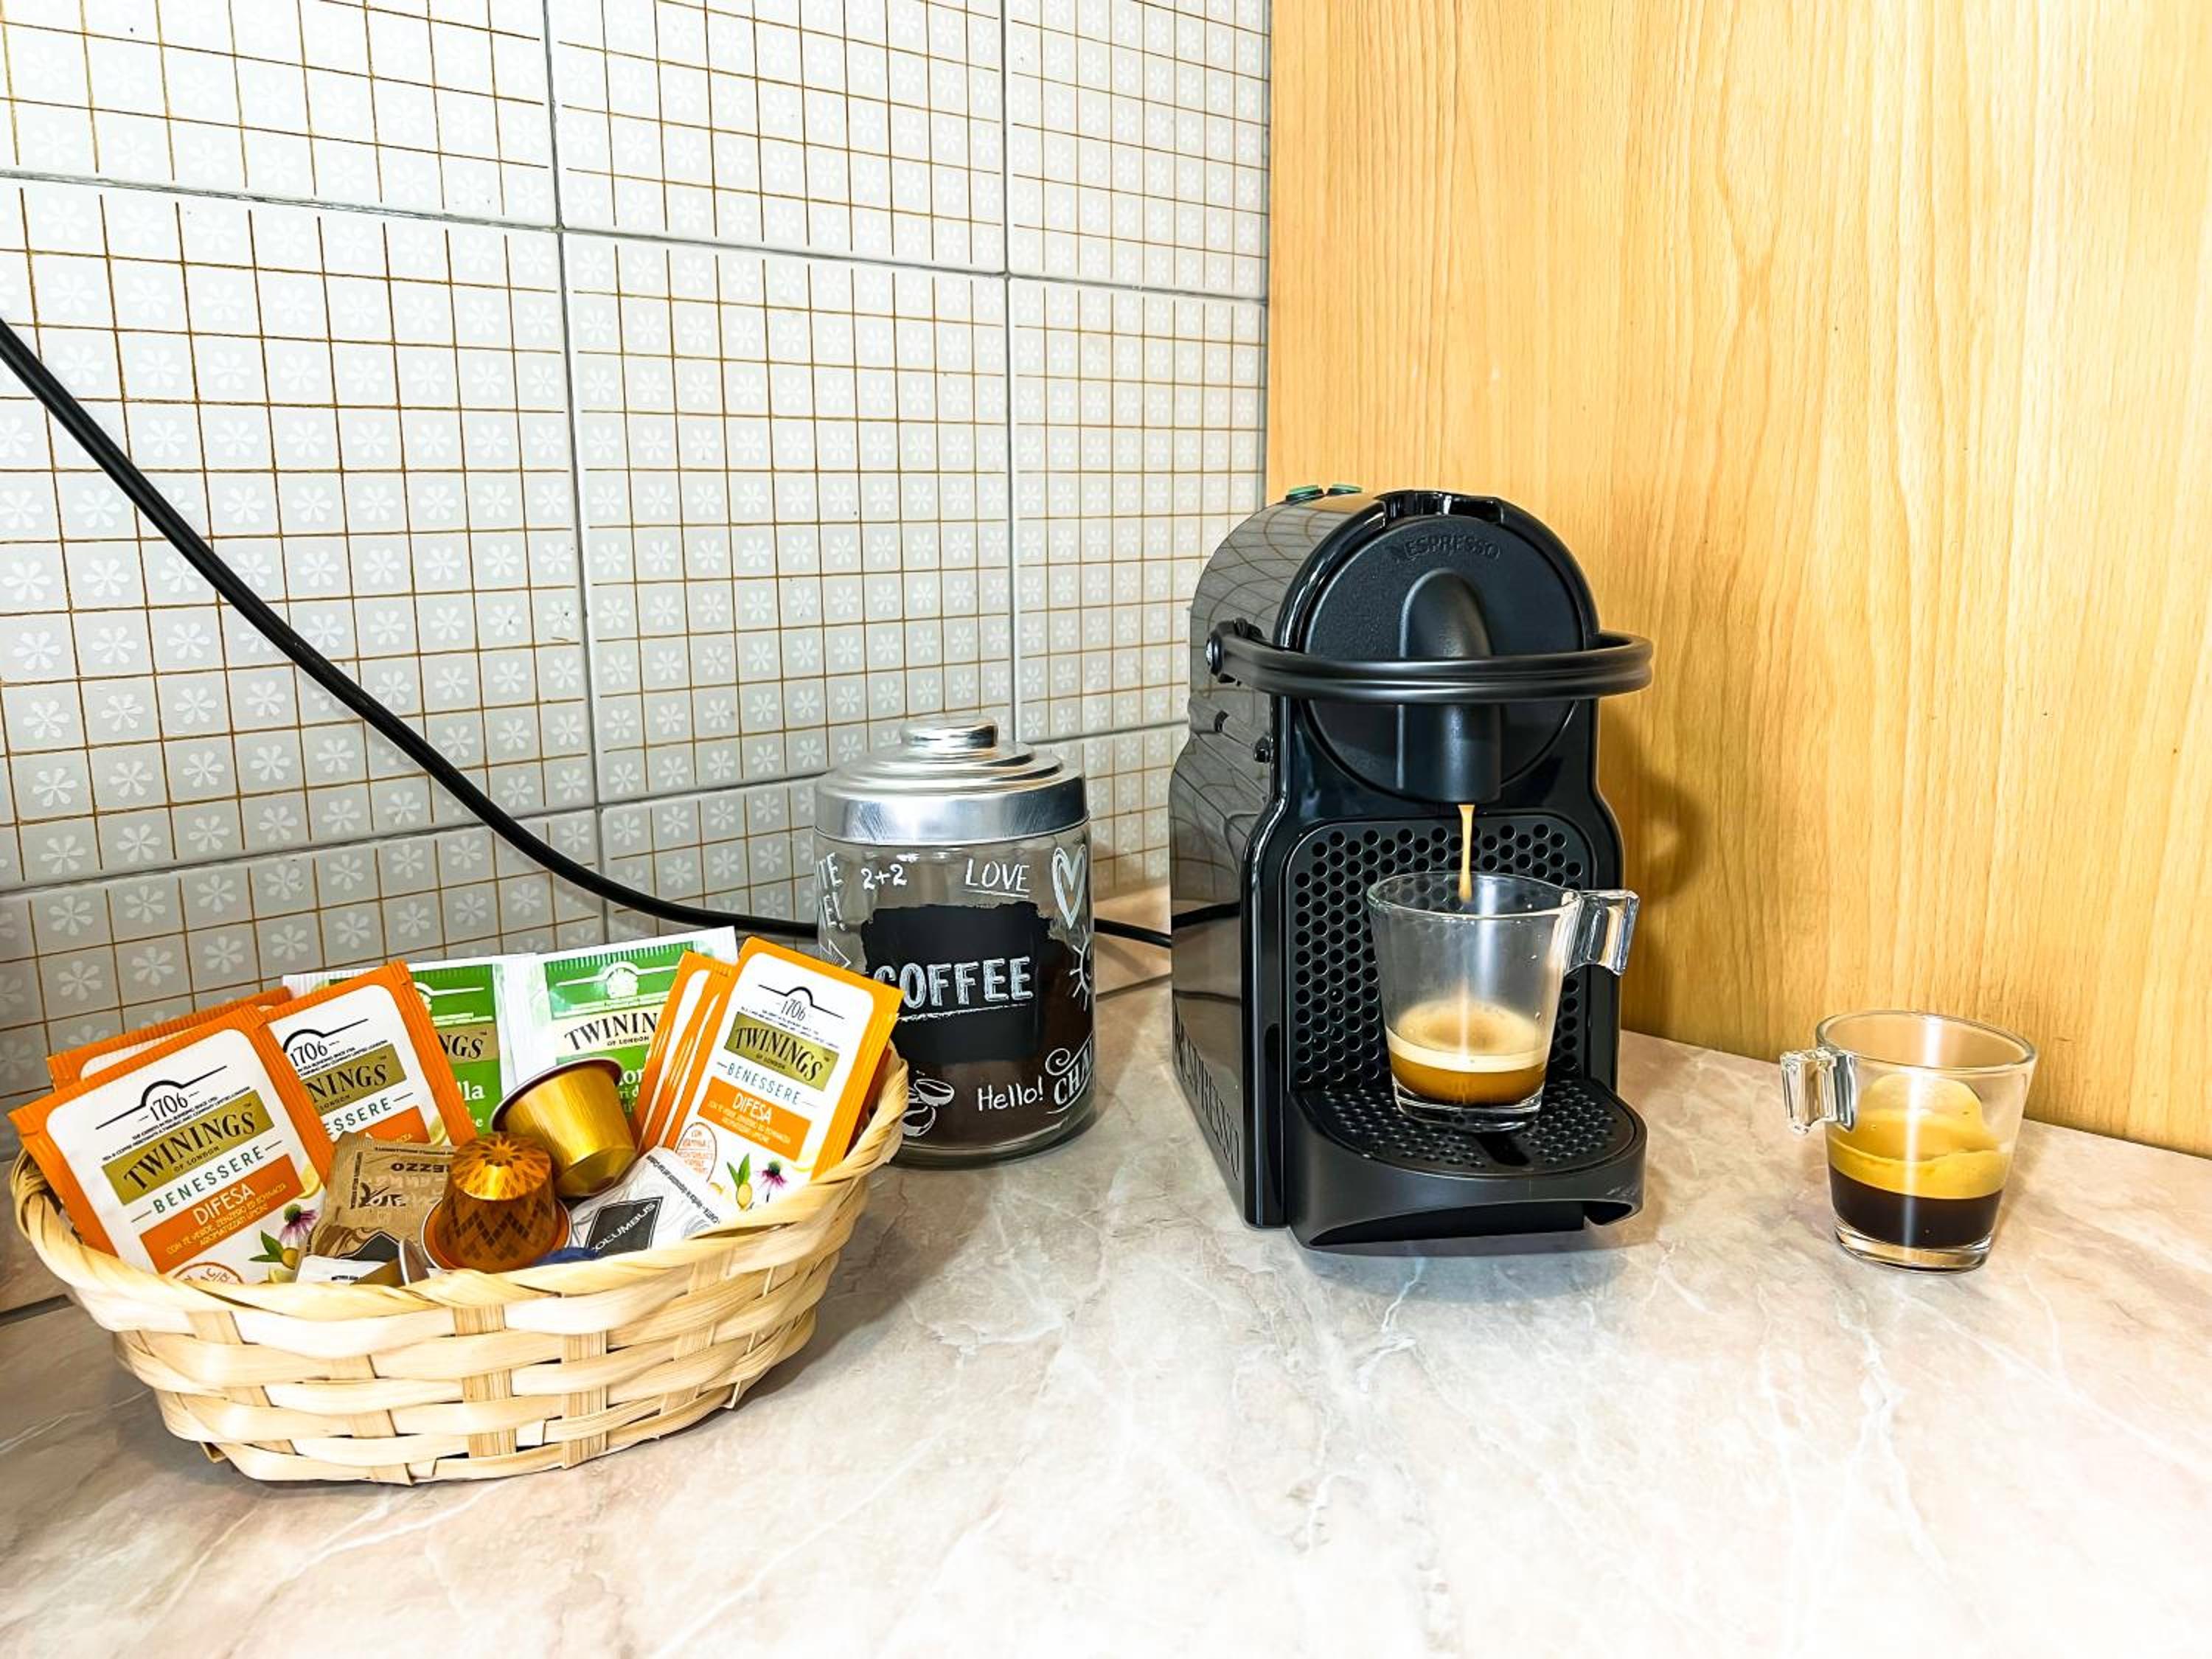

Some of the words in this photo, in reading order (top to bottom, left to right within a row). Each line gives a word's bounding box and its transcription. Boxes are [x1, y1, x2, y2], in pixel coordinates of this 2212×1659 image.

[1388, 534, 1501, 563] NESPRESSO
[861, 863, 908, 890] 2+2
[965, 858, 1030, 891] LOVE
[782, 998, 806, 1021] 1706
[290, 1041, 328, 1067] 1706
[619, 1035, 650, 1046] LONDON
[735, 1027, 823, 1082] TWININGS
[728, 1062, 801, 1105] BENESSERE
[977, 1076, 1043, 1111] Hello!
[150, 1092, 189, 1121] 1706
[732, 1093, 772, 1124] DIFESA
[124, 1112, 256, 1190] TWININGS
[174, 1164, 184, 1174] OF
[187, 1146, 220, 1166] LONDON
[153, 1146, 264, 1214] BENESSERE
[391, 1162, 450, 1173] EZZO
[192, 1183, 256, 1226] DIFESA
[593, 1203, 655, 1251] OLUMBUS
